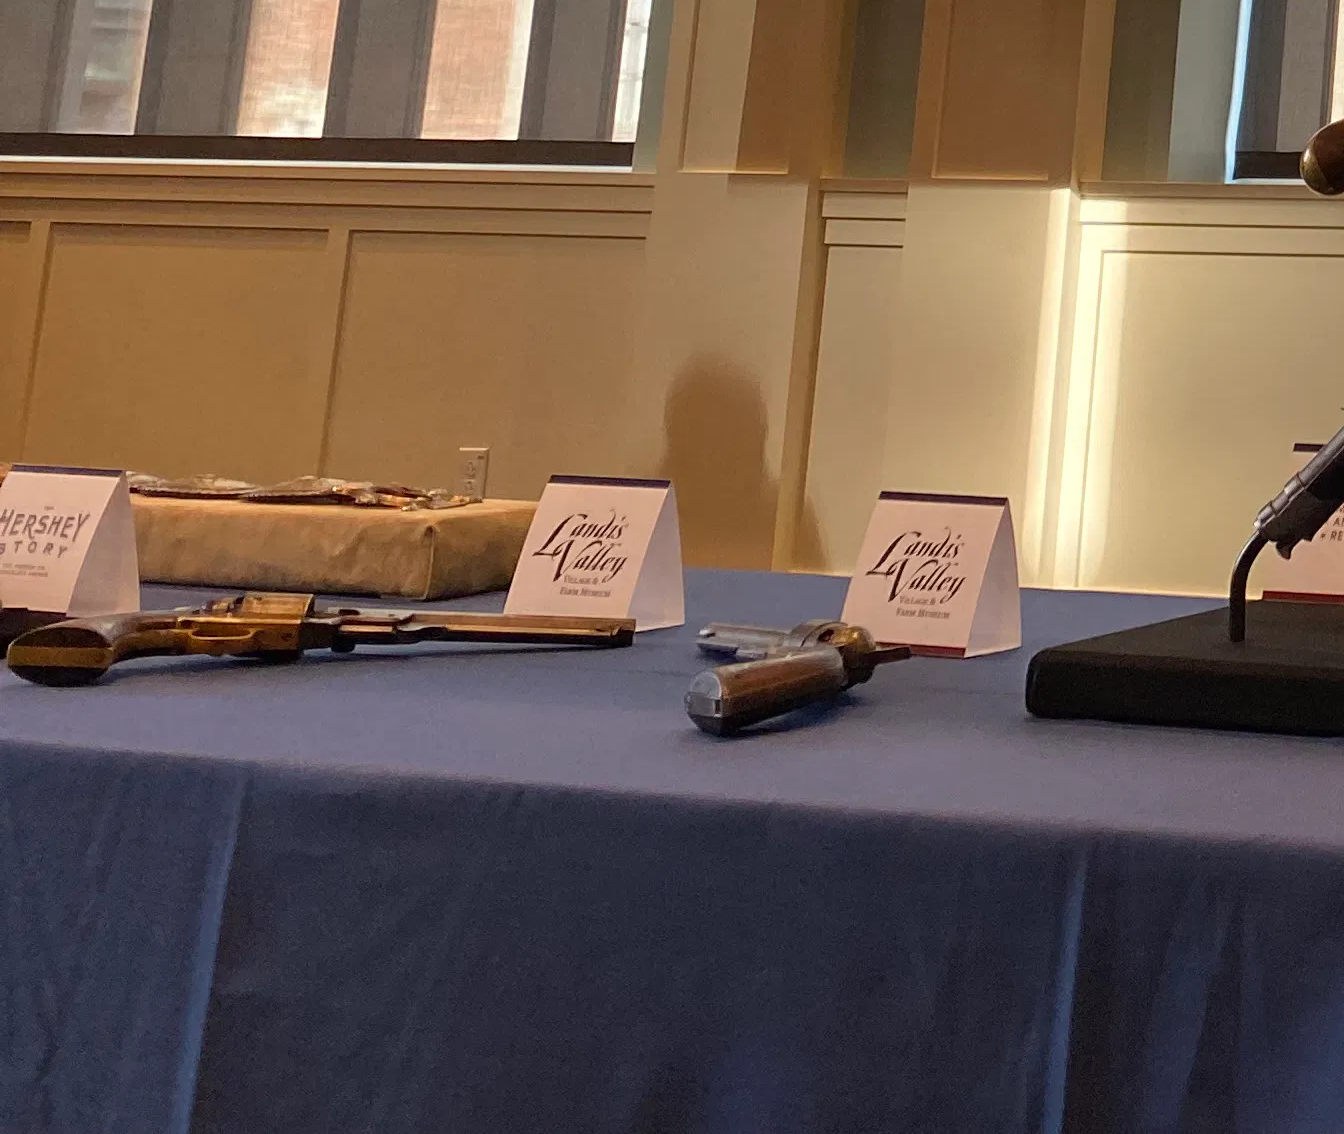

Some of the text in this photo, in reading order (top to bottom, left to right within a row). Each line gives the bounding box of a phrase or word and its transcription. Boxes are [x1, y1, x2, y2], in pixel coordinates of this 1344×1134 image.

[0, 509, 91, 543] HERSHEY
[532, 508, 630, 557] Landis
[552, 540, 628, 584] Valley
[865, 525, 965, 576] Landis
[888, 558, 967, 605] Valley
